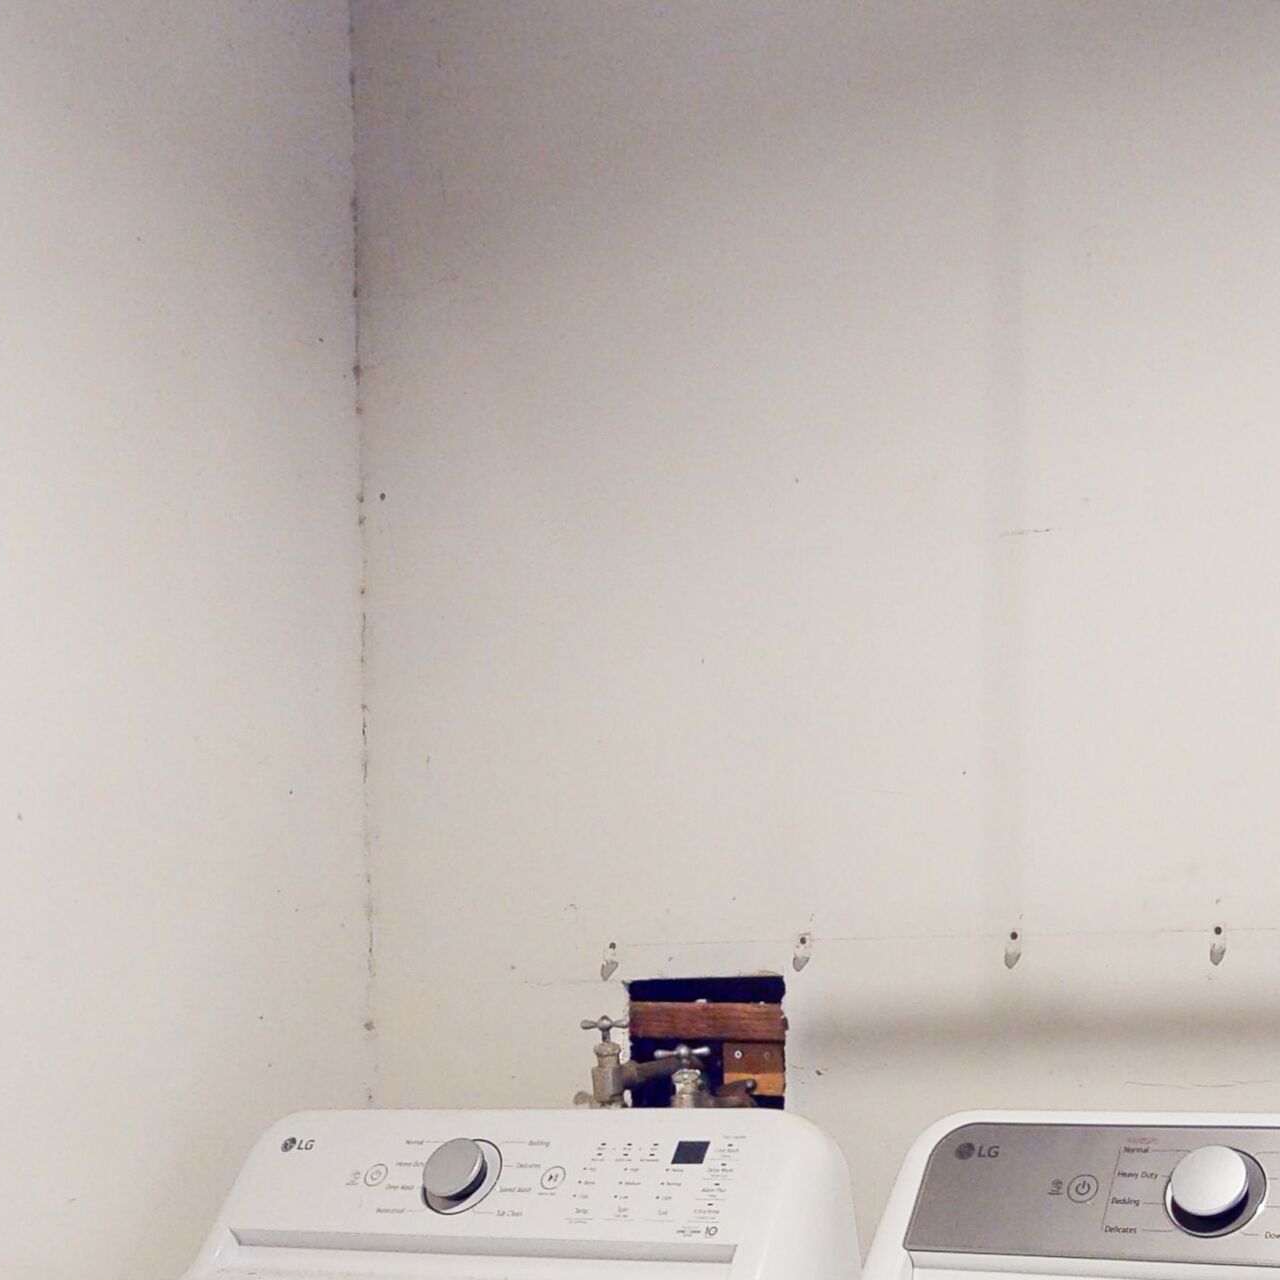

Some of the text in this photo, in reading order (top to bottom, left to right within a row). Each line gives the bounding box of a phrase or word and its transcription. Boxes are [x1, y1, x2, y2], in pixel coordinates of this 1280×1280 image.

[297, 1139, 315, 1150] LG
[977, 1145, 1000, 1158] LG
[1117, 1170, 1159, 1180] Heavy Duty
[1111, 1196, 1140, 1207] Bedding
[705, 1226, 718, 1236] 10
[1104, 1225, 1137, 1234] Delicates
